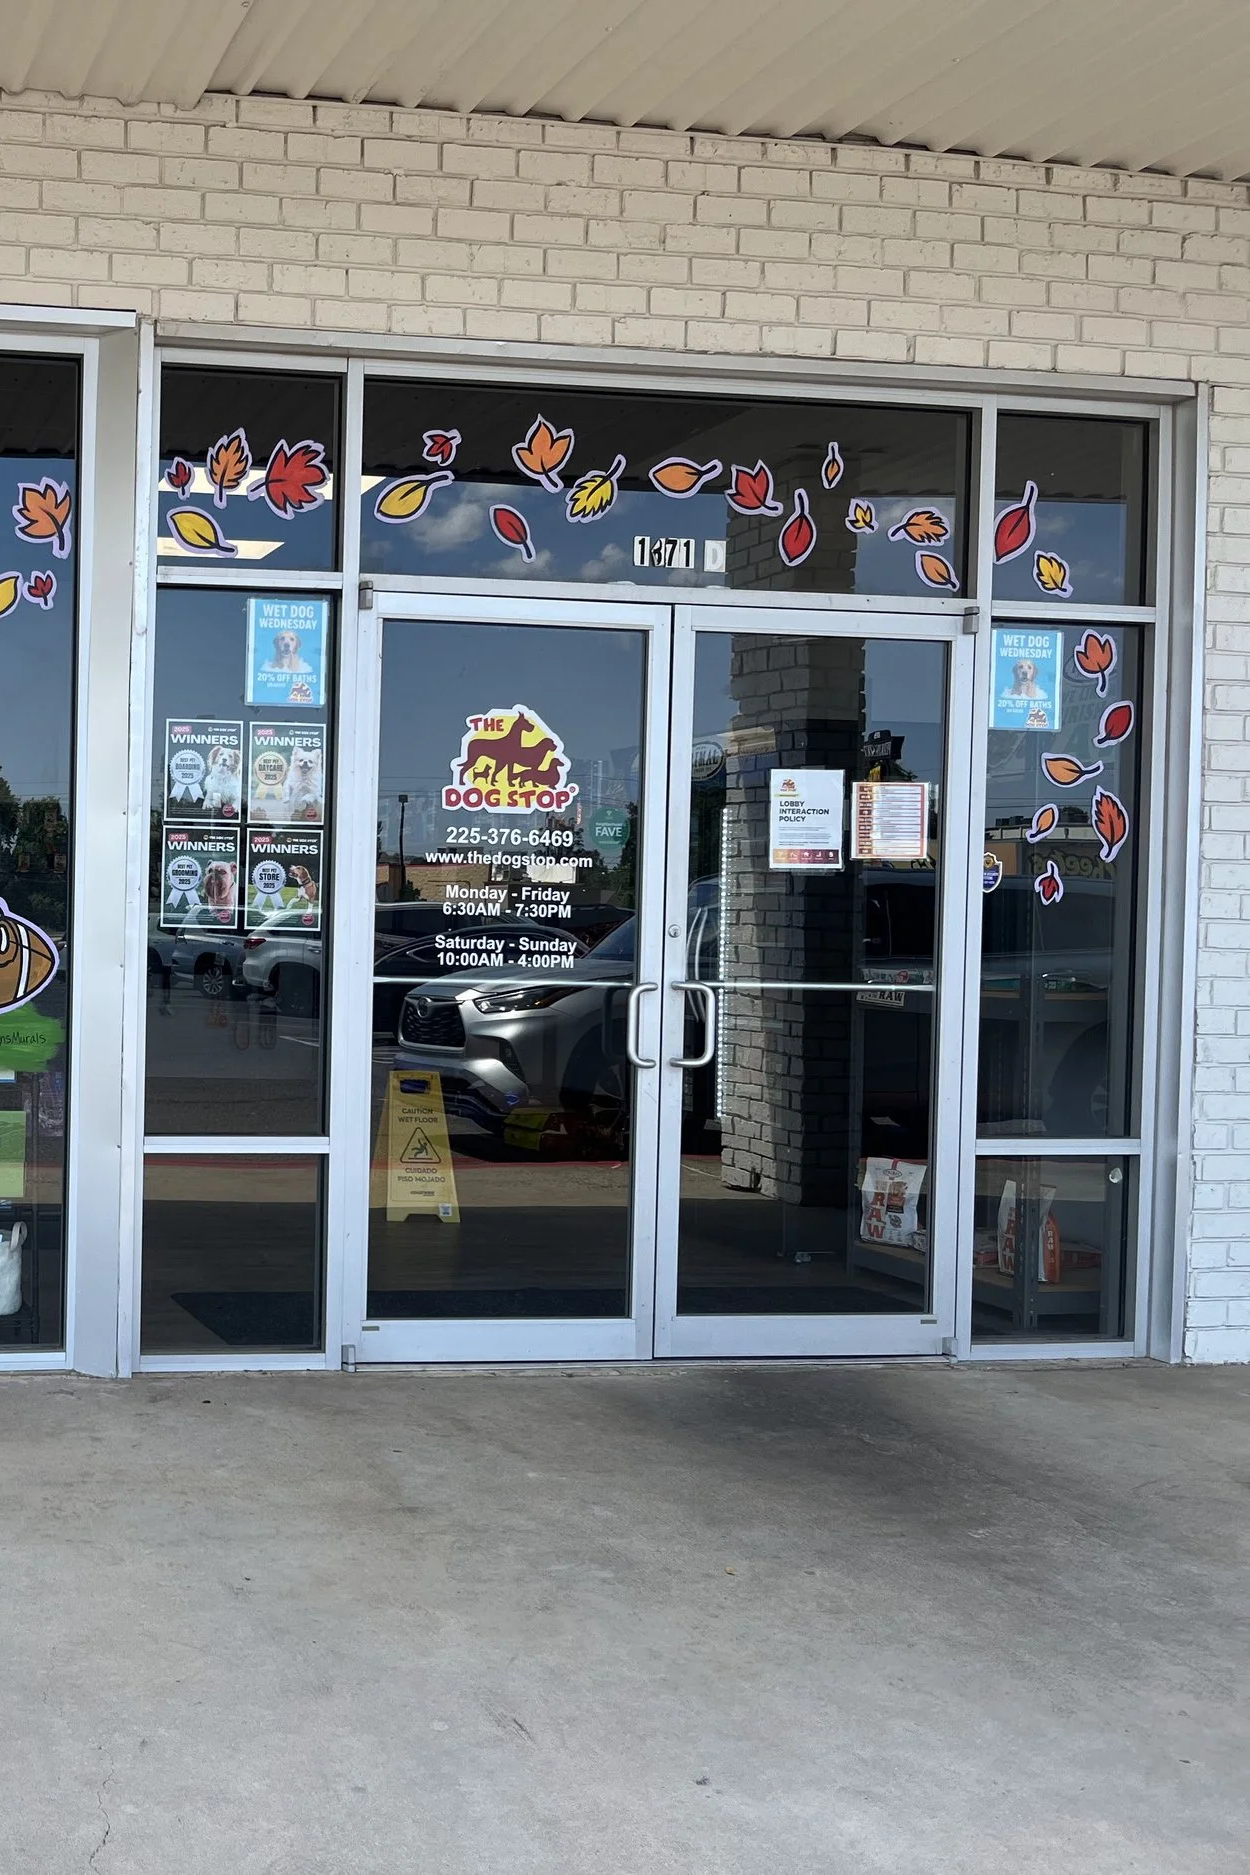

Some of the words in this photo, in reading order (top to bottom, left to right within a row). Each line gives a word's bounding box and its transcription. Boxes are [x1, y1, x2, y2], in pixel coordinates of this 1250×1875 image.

[263, 604, 288, 617] WET
[291, 605, 314, 618] DOG
[259, 618, 318, 630] WEDNESDAY
[1003, 634, 1026, 647] WET
[1028, 635, 1049, 648] DOG
[1000, 647, 1053, 658] WEDNESDAY
[257, 673, 275, 682] 20%
[277, 674, 290, 682] OFF
[292, 675, 317, 683] BATHS
[998, 700, 1014, 708] 20%
[1015, 700, 1028, 708] OFF
[1030, 701, 1052, 709] BATHS
[469, 718, 504, 732] THE
[170, 734, 238, 745] WINNERS
[254, 736, 321, 747] WINNERS
[445, 788, 500, 808] DOG
[507, 790, 571, 809] STOP
[446, 827, 573, 847] 225-376-6469
[595, 827, 623, 837] FAVE
[167, 841, 235, 852] WINNERS
[251, 844, 318, 854] WINNERS
[425, 851, 593, 869] www.thedogstop.com
[259, 873, 280, 881] STORE
[446, 885, 507, 902] Monday
[521, 887, 570, 903] Friday
[443, 902, 500, 917] 6:30AM
[515, 904, 571, 918] 7:30PM
[435, 935, 505, 951] Saturday
[519, 938, 577, 953] Sunday
[437, 952, 504, 967] 10:00AM
[517, 954, 574, 968] 4:00PM
[879, 991, 904, 1001] RAW
[866, 1192, 886, 1238] RAW
